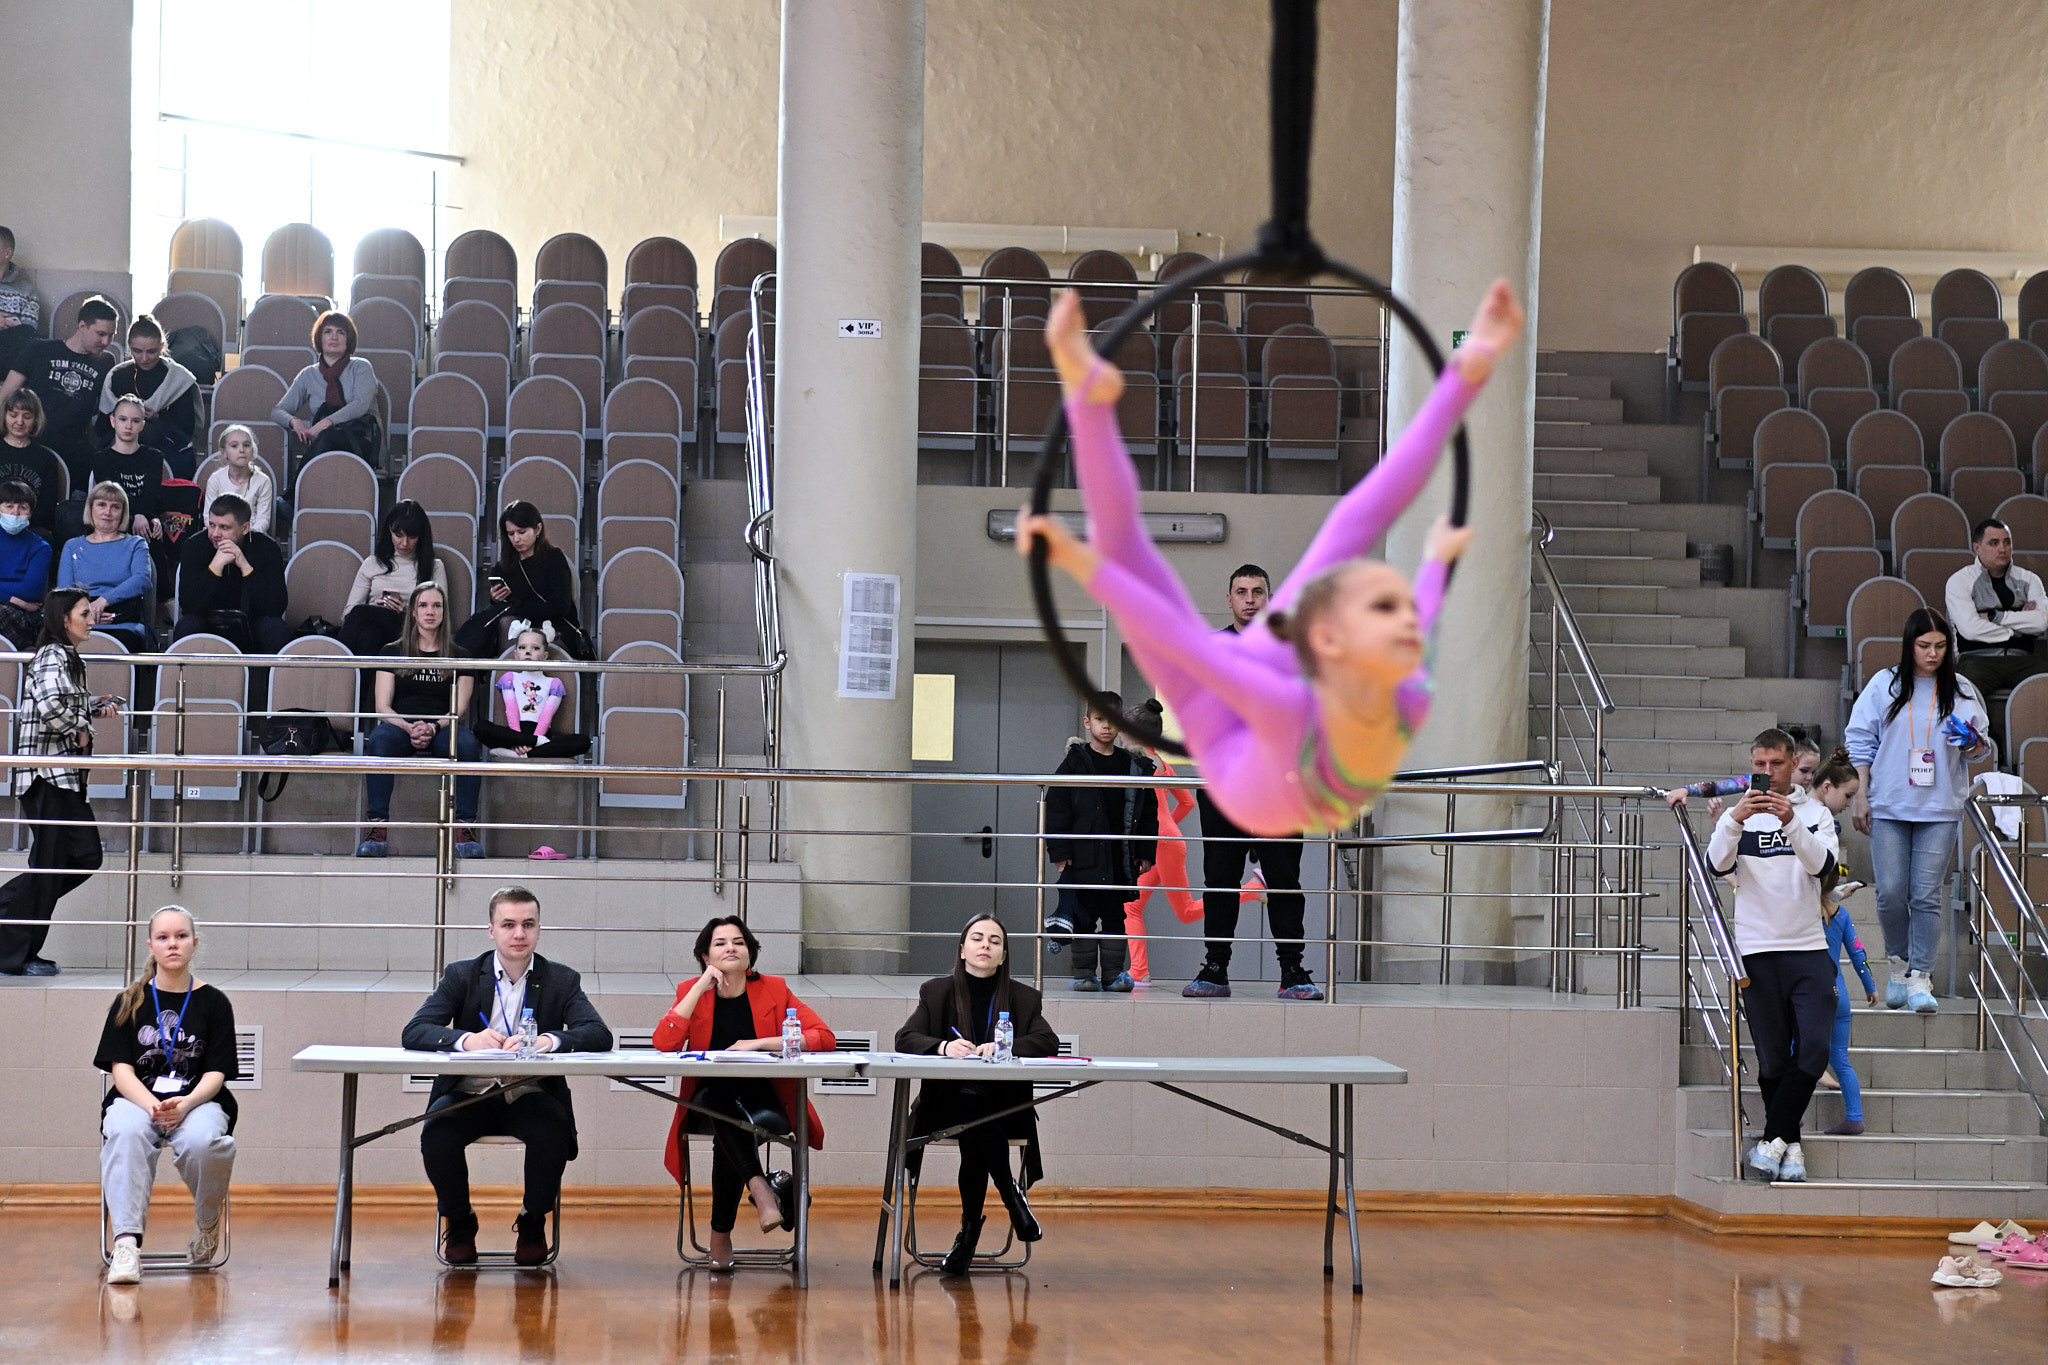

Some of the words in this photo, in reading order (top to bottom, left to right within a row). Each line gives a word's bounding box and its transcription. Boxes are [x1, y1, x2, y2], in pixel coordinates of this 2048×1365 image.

[858, 322, 874, 330] VIP
[50, 359, 69, 368] TOM
[71, 361, 99, 379] TAILOR
[48, 370, 62, 381] 19
